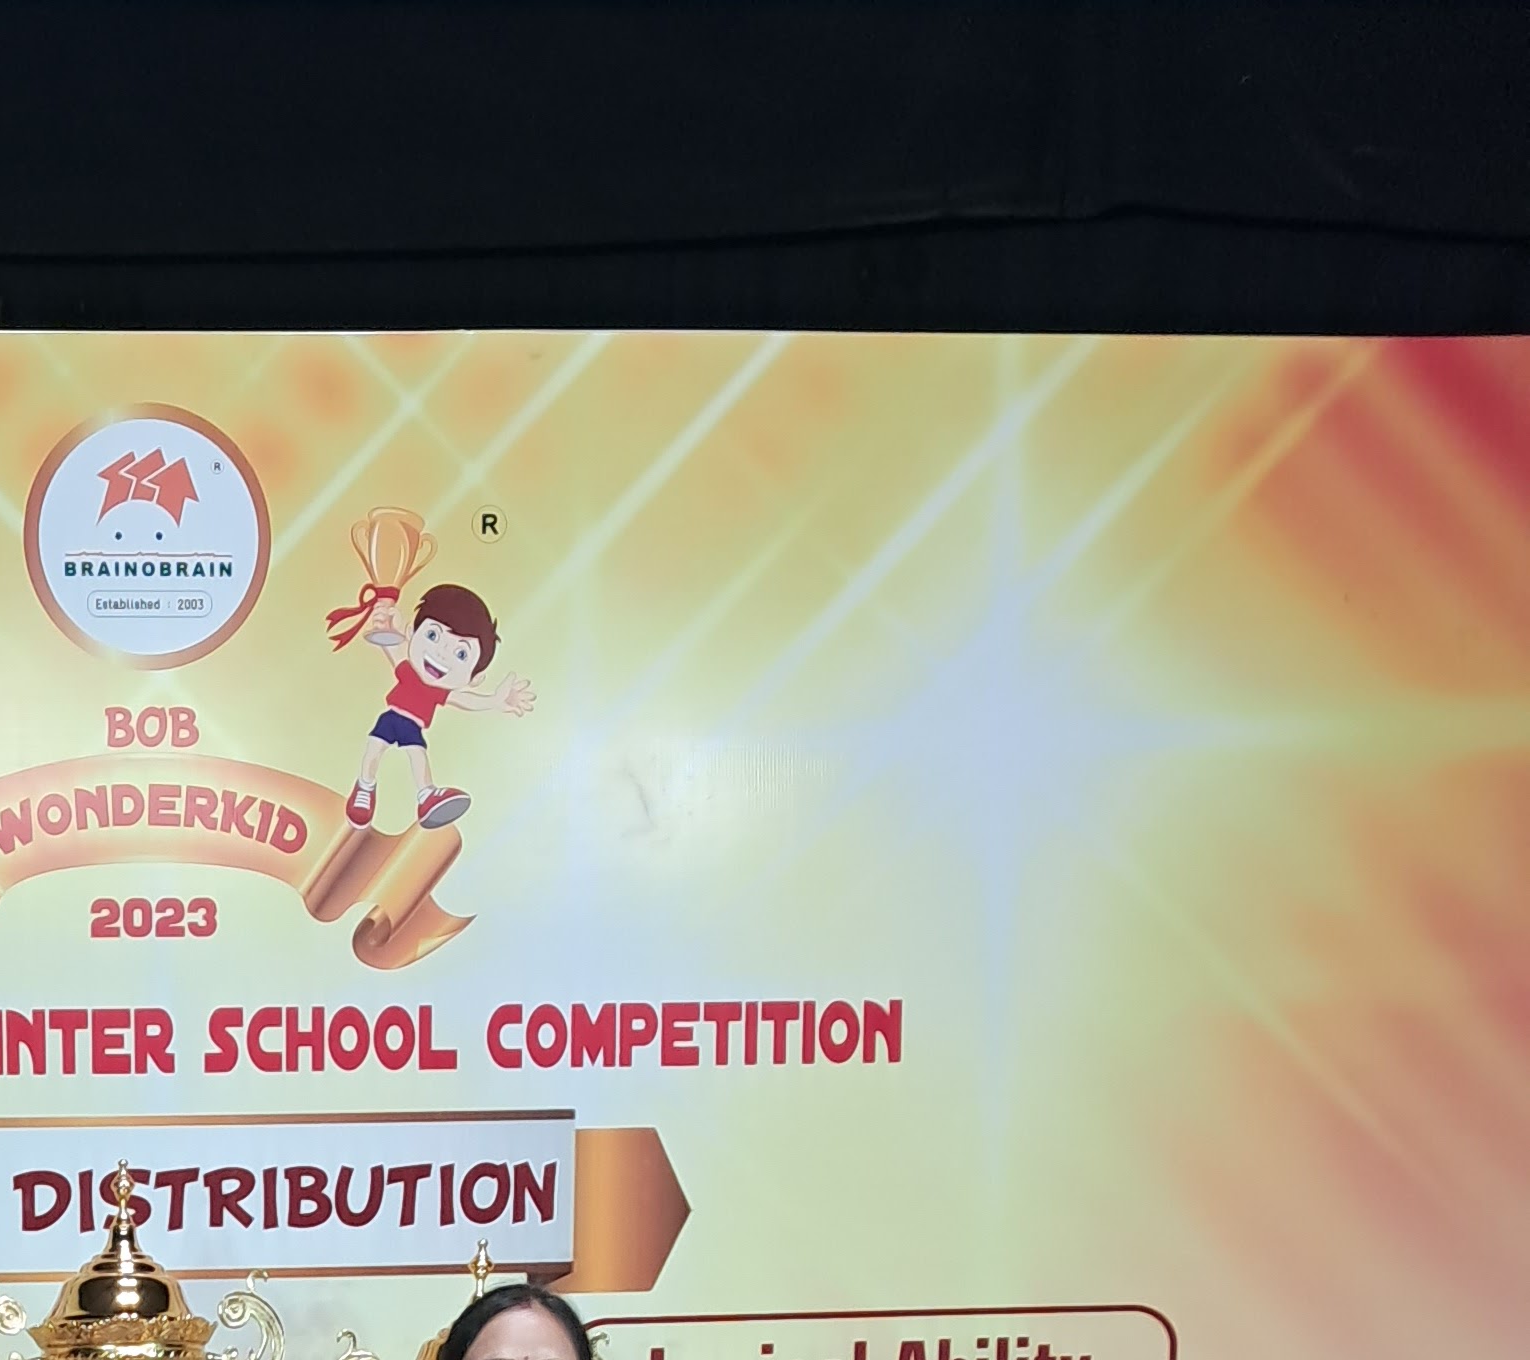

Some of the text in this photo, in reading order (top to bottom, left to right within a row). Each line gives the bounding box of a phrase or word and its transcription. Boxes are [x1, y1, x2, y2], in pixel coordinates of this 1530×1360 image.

[64, 561, 233, 577] BRAINOBRAIN
[95, 598, 161, 610] Established
[177, 598, 205, 610] 2003
[104, 706, 200, 748] BOB
[89, 897, 219, 939] 2023
[204, 1005, 458, 1074] SCHOOL
[486, 999, 903, 1069] COMPETITION
[13, 1160, 559, 1234] DISTRIBUTION
